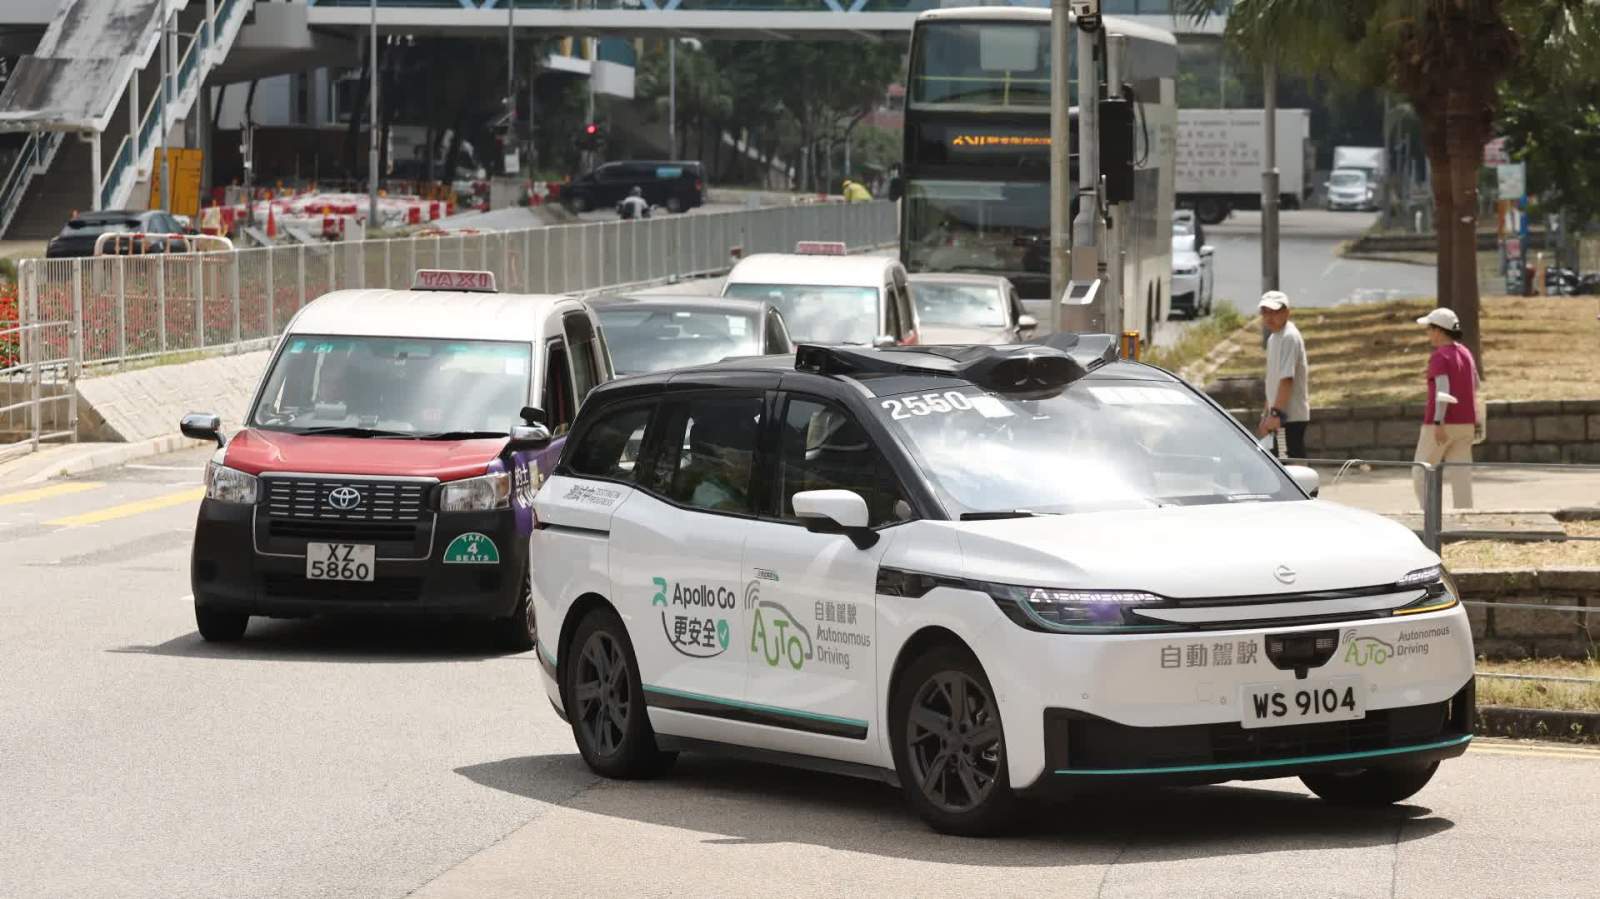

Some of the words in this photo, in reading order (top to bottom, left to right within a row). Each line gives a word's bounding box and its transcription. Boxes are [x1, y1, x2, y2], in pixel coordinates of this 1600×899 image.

[420, 271, 488, 287] TAXI
[881, 391, 972, 420] 2550
[461, 534, 485, 543] TAXI
[467, 542, 479, 554] 4
[327, 543, 356, 562] XZ
[455, 554, 490, 562] SEATS
[311, 561, 369, 580] 5860
[672, 582, 716, 609] Apollo
[717, 586, 736, 610] Go
[814, 600, 858, 625] 自動駕駛
[673, 615, 716, 649] 更安全
[816, 623, 871, 648] Autonomous
[1398, 625, 1450, 643] Autonomous
[817, 645, 850, 670] Driving
[1160, 638, 1259, 669] 自動駕駛
[1397, 643, 1429, 658] Driving
[1253, 692, 1289, 719] WS
[1295, 686, 1356, 716] 9104
